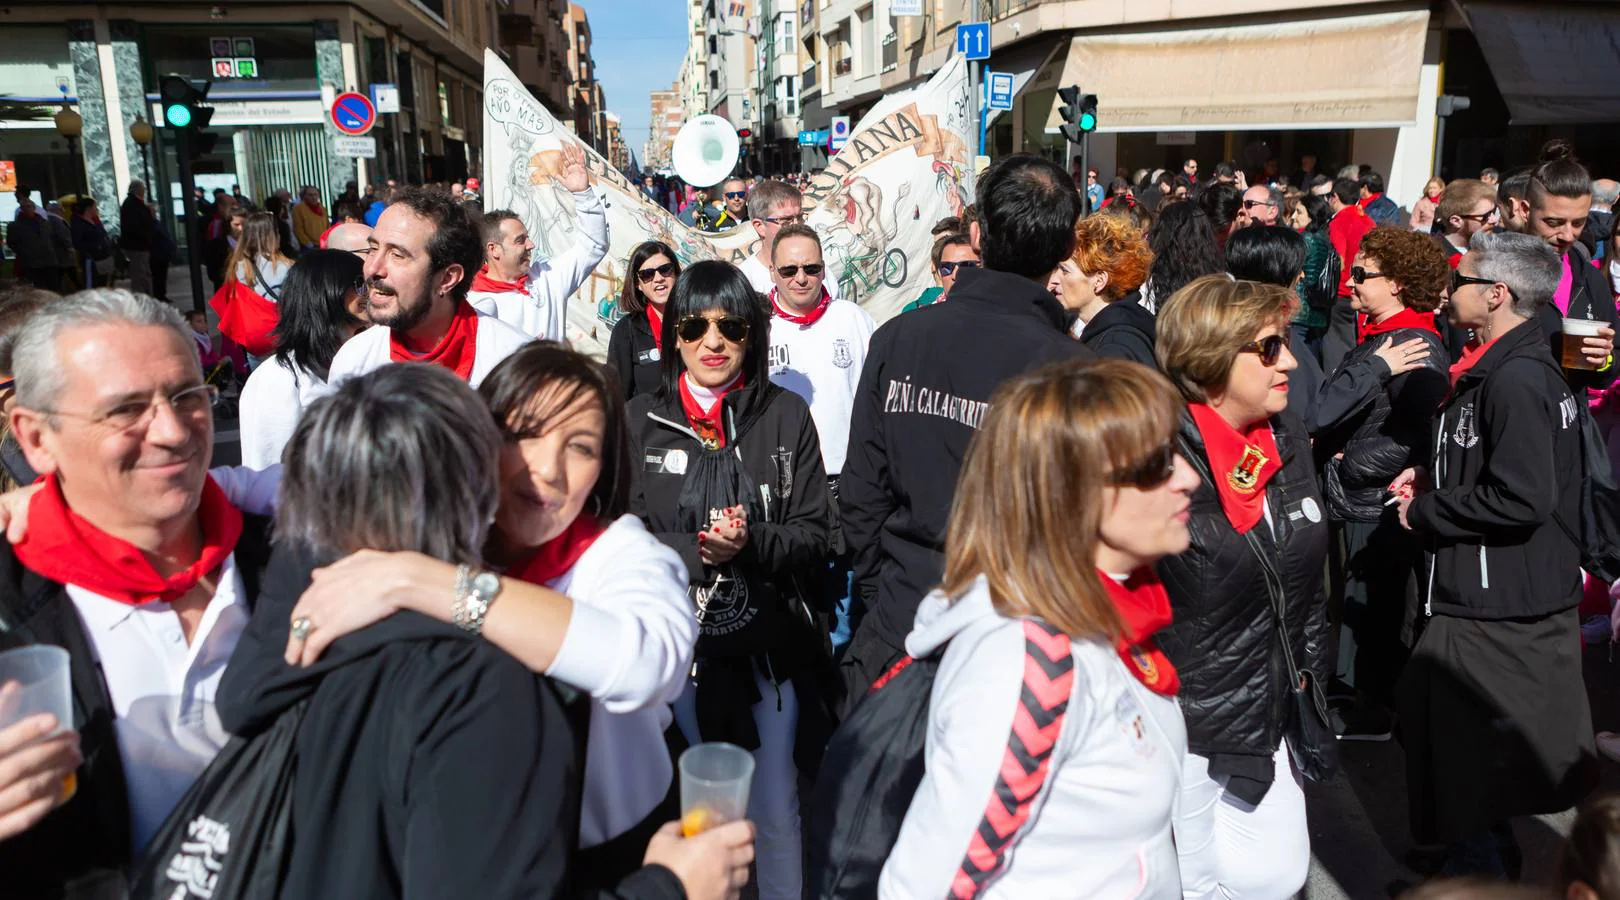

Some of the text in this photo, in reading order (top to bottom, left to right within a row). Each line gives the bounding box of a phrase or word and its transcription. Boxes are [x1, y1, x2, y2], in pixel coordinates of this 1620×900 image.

[493, 84, 509, 96] POR
[491, 95, 544, 130] AÑO MAS
[917, 387, 993, 431] CALAGURRIT
